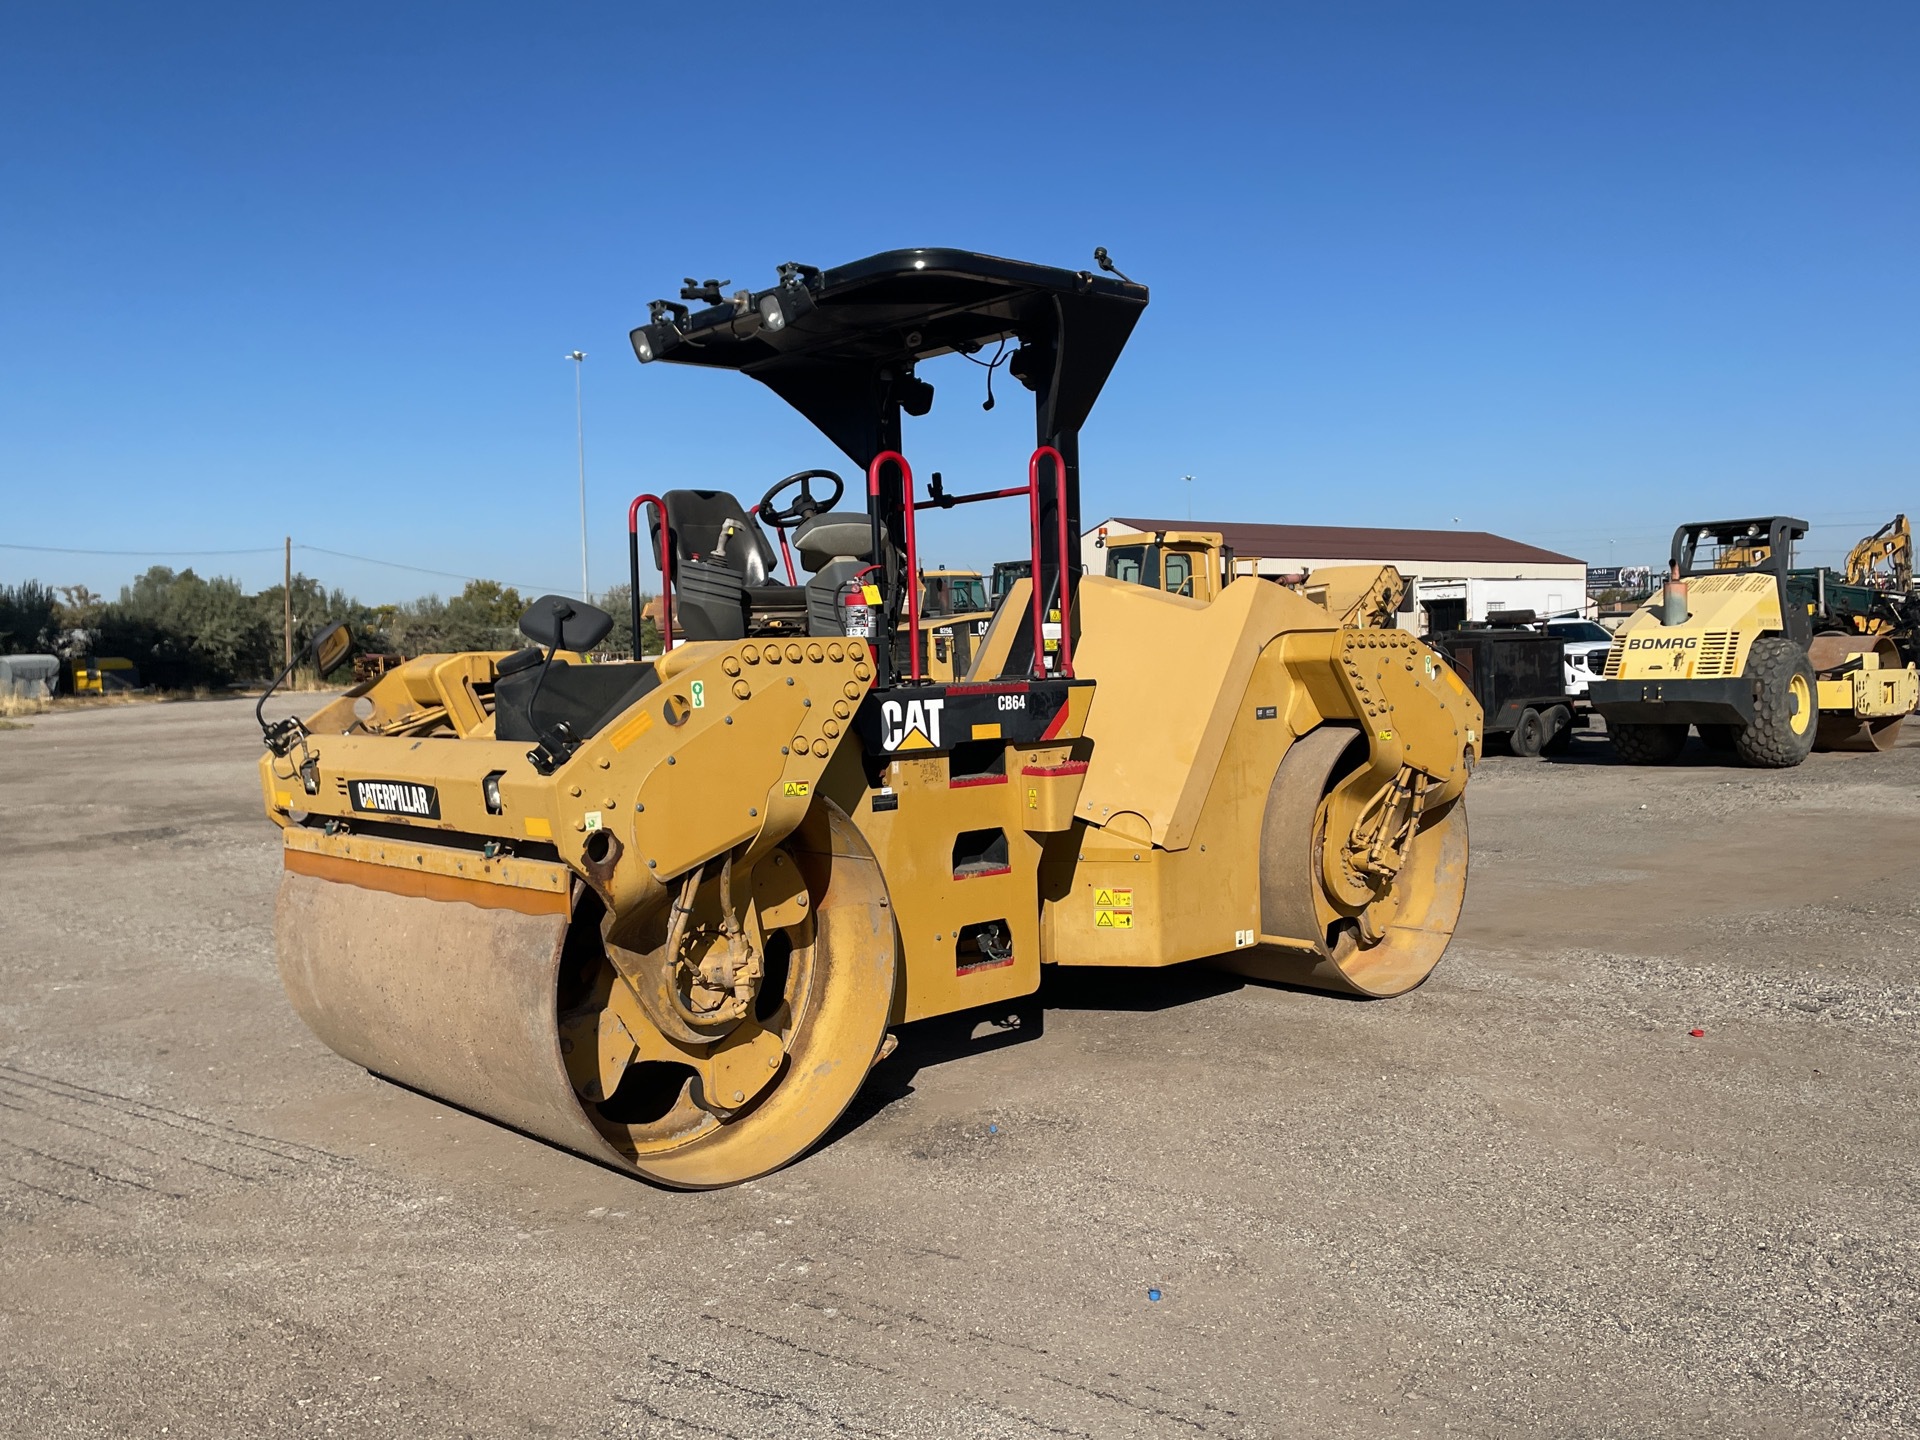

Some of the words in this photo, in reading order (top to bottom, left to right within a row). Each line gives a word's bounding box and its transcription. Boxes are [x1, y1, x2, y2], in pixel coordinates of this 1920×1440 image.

[977, 621, 990, 636] CA
[1628, 637, 1698, 650] BOMAG
[997, 695, 1026, 711] CB64
[881, 698, 944, 751] CAT
[357, 782, 429, 815] CATERPILLAR
